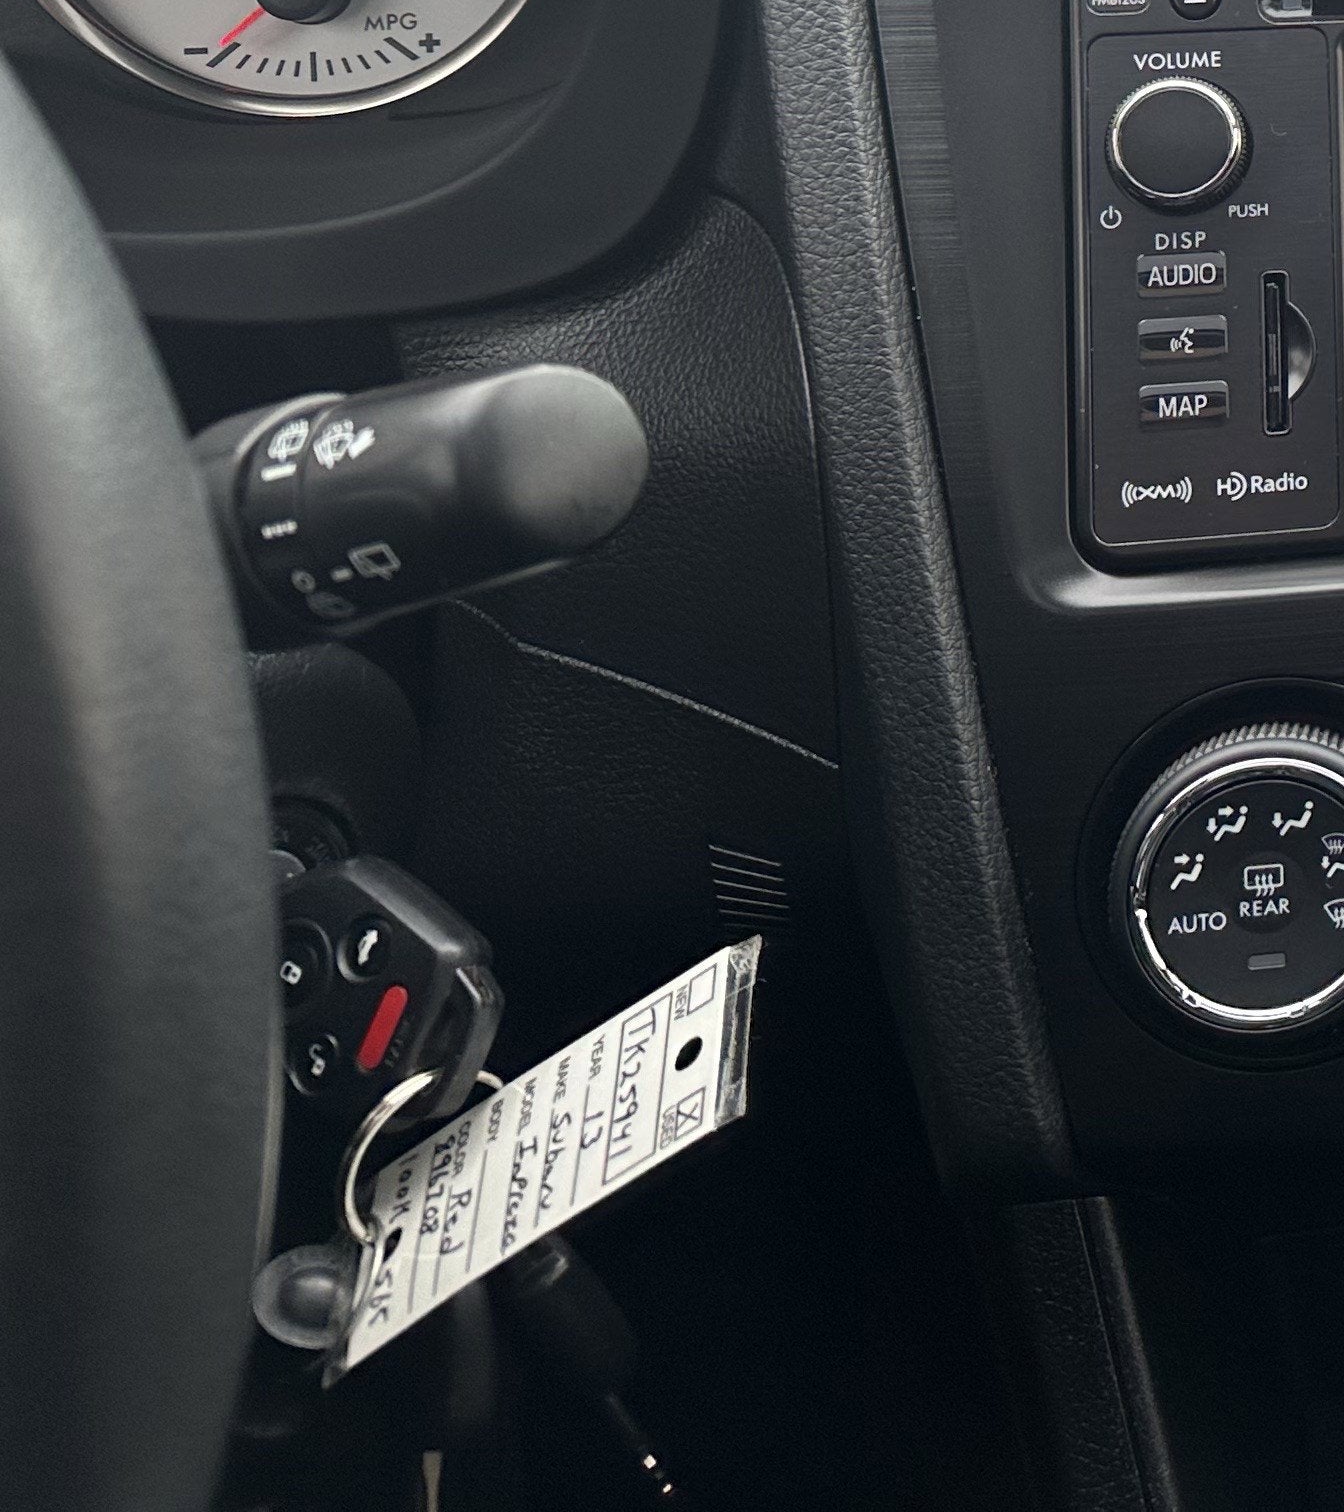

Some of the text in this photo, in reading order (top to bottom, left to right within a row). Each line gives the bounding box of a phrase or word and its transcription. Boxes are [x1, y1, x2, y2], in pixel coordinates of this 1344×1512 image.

[364, 12, 418, 31] MPG
[1133, 50, 1222, 71] VOLUME
[1228, 203, 1269, 218] PUSH
[1155, 231, 1207, 251] DISP
[1147, 262, 1217, 287] AUDIO
[1158, 394, 1208, 419] MAP
[1250, 472, 1308, 495] Radio
[1239, 897, 1290, 918] REAR
[1167, 911, 1227, 935] AUTO
[674, 984, 688, 1021] NEW
[589, 1034, 606, 1081] YEAR
[553, 1056, 571, 1104] MAKE
[607, 1007, 656, 1161] TK25941
[519, 1076, 537, 1135] MODEL
[489, 1099, 504, 1143] BODY
[580, 1111, 604, 1150] 13
[452, 1120, 472, 1177] COLOR
